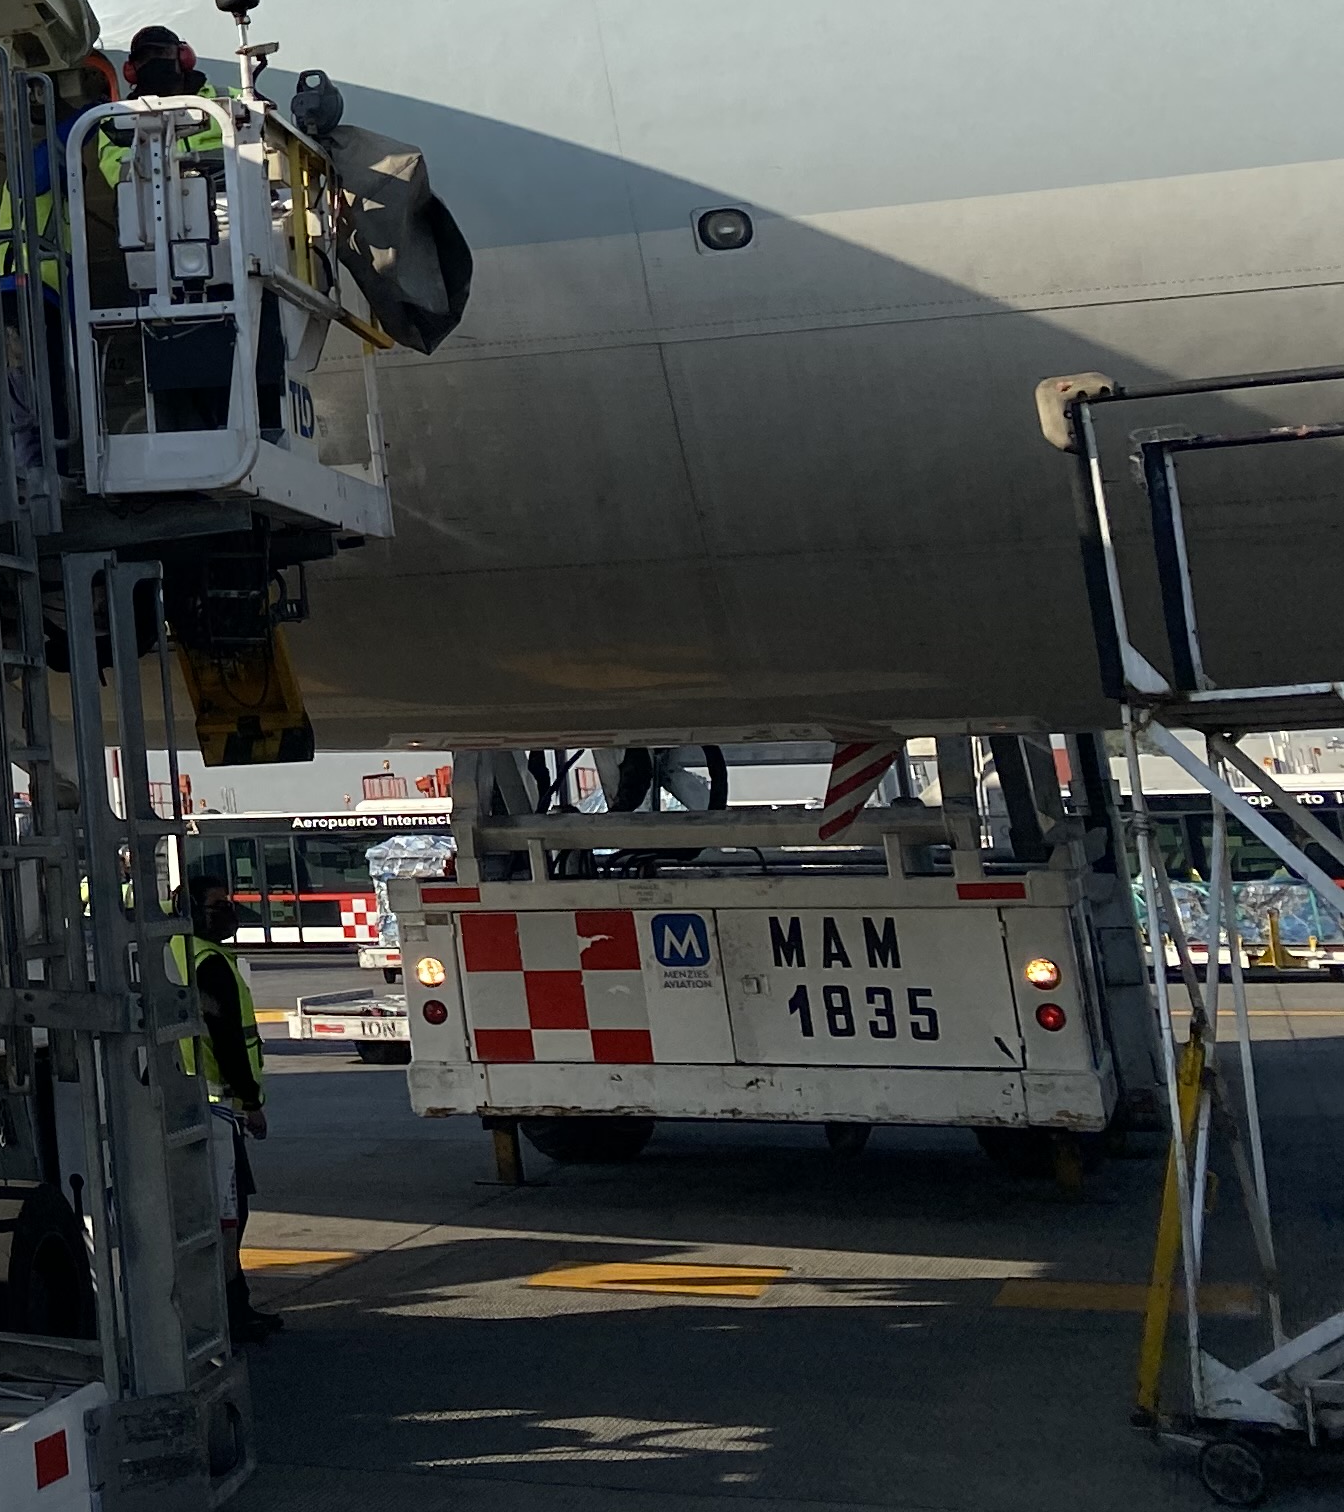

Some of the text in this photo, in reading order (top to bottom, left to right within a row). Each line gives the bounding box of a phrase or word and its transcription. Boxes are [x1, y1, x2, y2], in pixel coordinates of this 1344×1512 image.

[292, 815, 378, 830] Aeropuerto
[663, 970, 709, 979] MENZIES
[663, 979, 712, 988] AVIATION
[788, 984, 940, 1041] 1835
